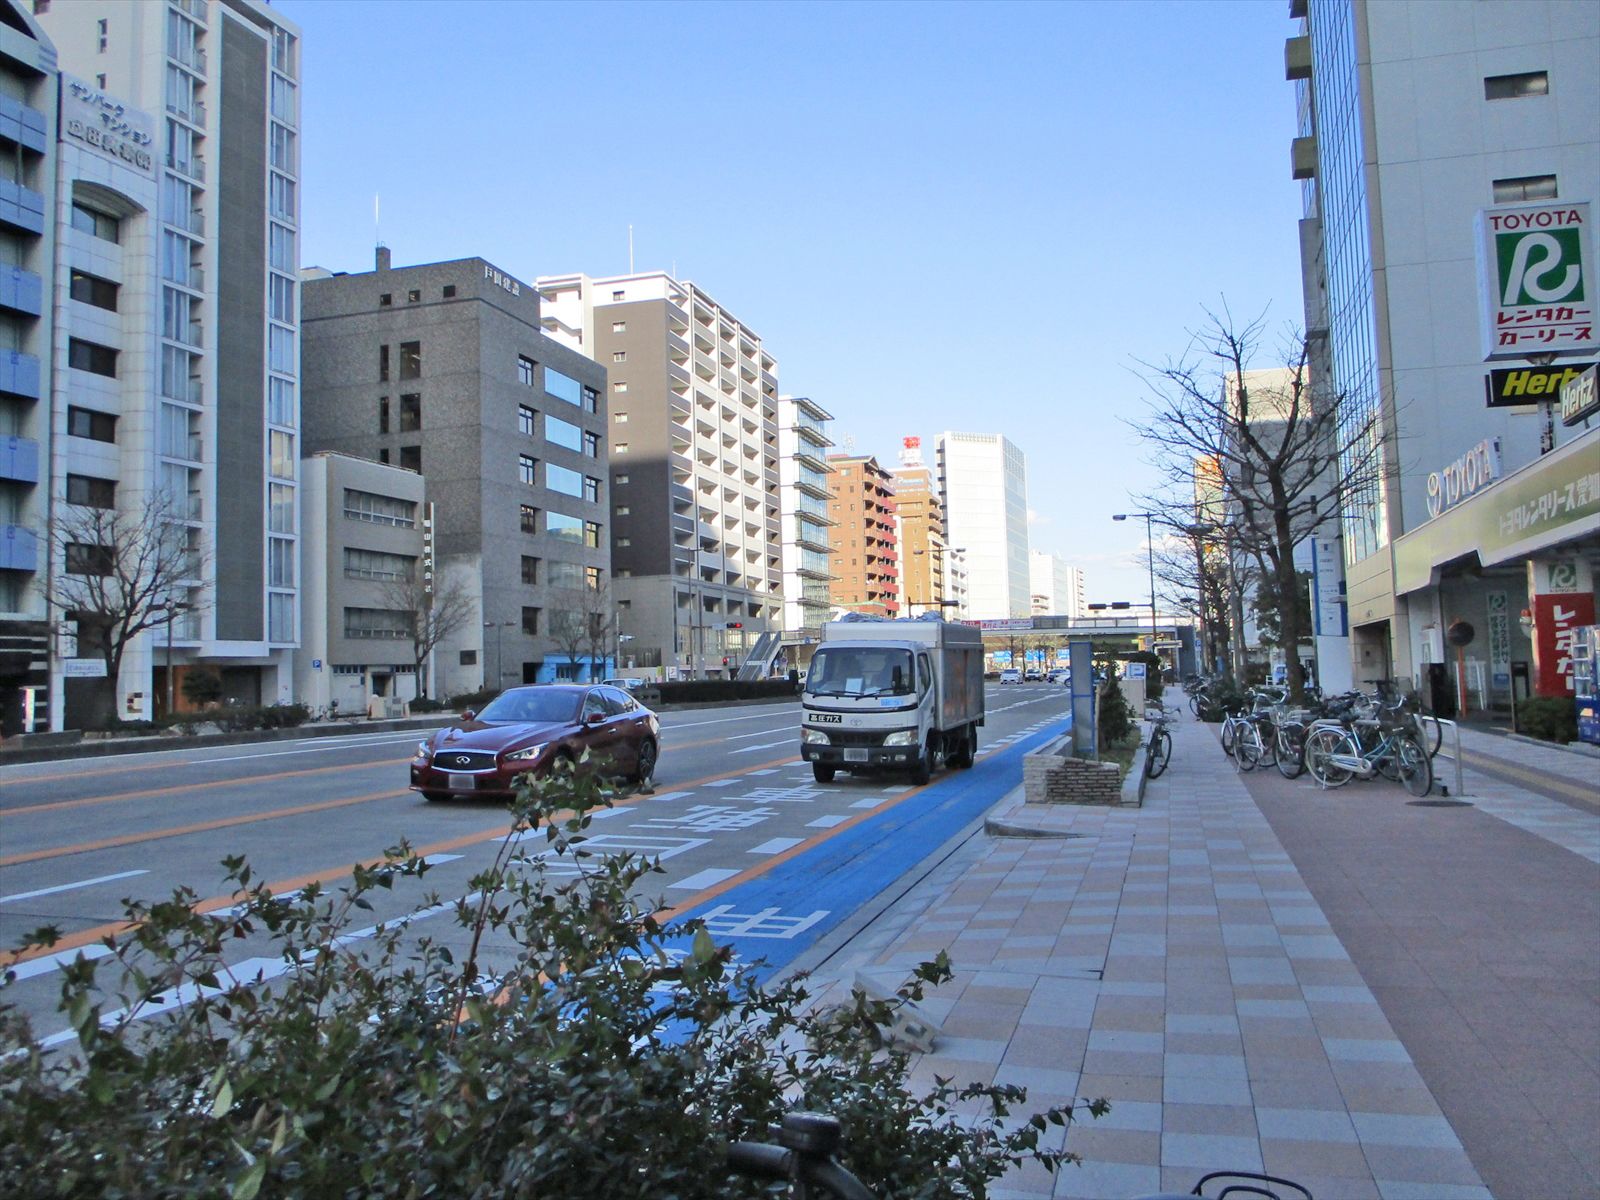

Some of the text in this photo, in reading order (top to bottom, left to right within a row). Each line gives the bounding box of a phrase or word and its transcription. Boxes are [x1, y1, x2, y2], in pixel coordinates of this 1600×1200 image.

[1489, 210, 1582, 231] TOYOTA
[1497, 306, 1591, 325] レンタカー
[1499, 326, 1592, 346] カーリース
[1502, 368, 1580, 396] Hert
[1561, 376, 1595, 420] Hertz
[1443, 439, 1491, 505] TOYOTA
[1498, 472, 1600, 537] トヨタレンタリース愛知
[1553, 605, 1576, 690] レンタカー
[810, 714, 840, 723] 高圧ガス
